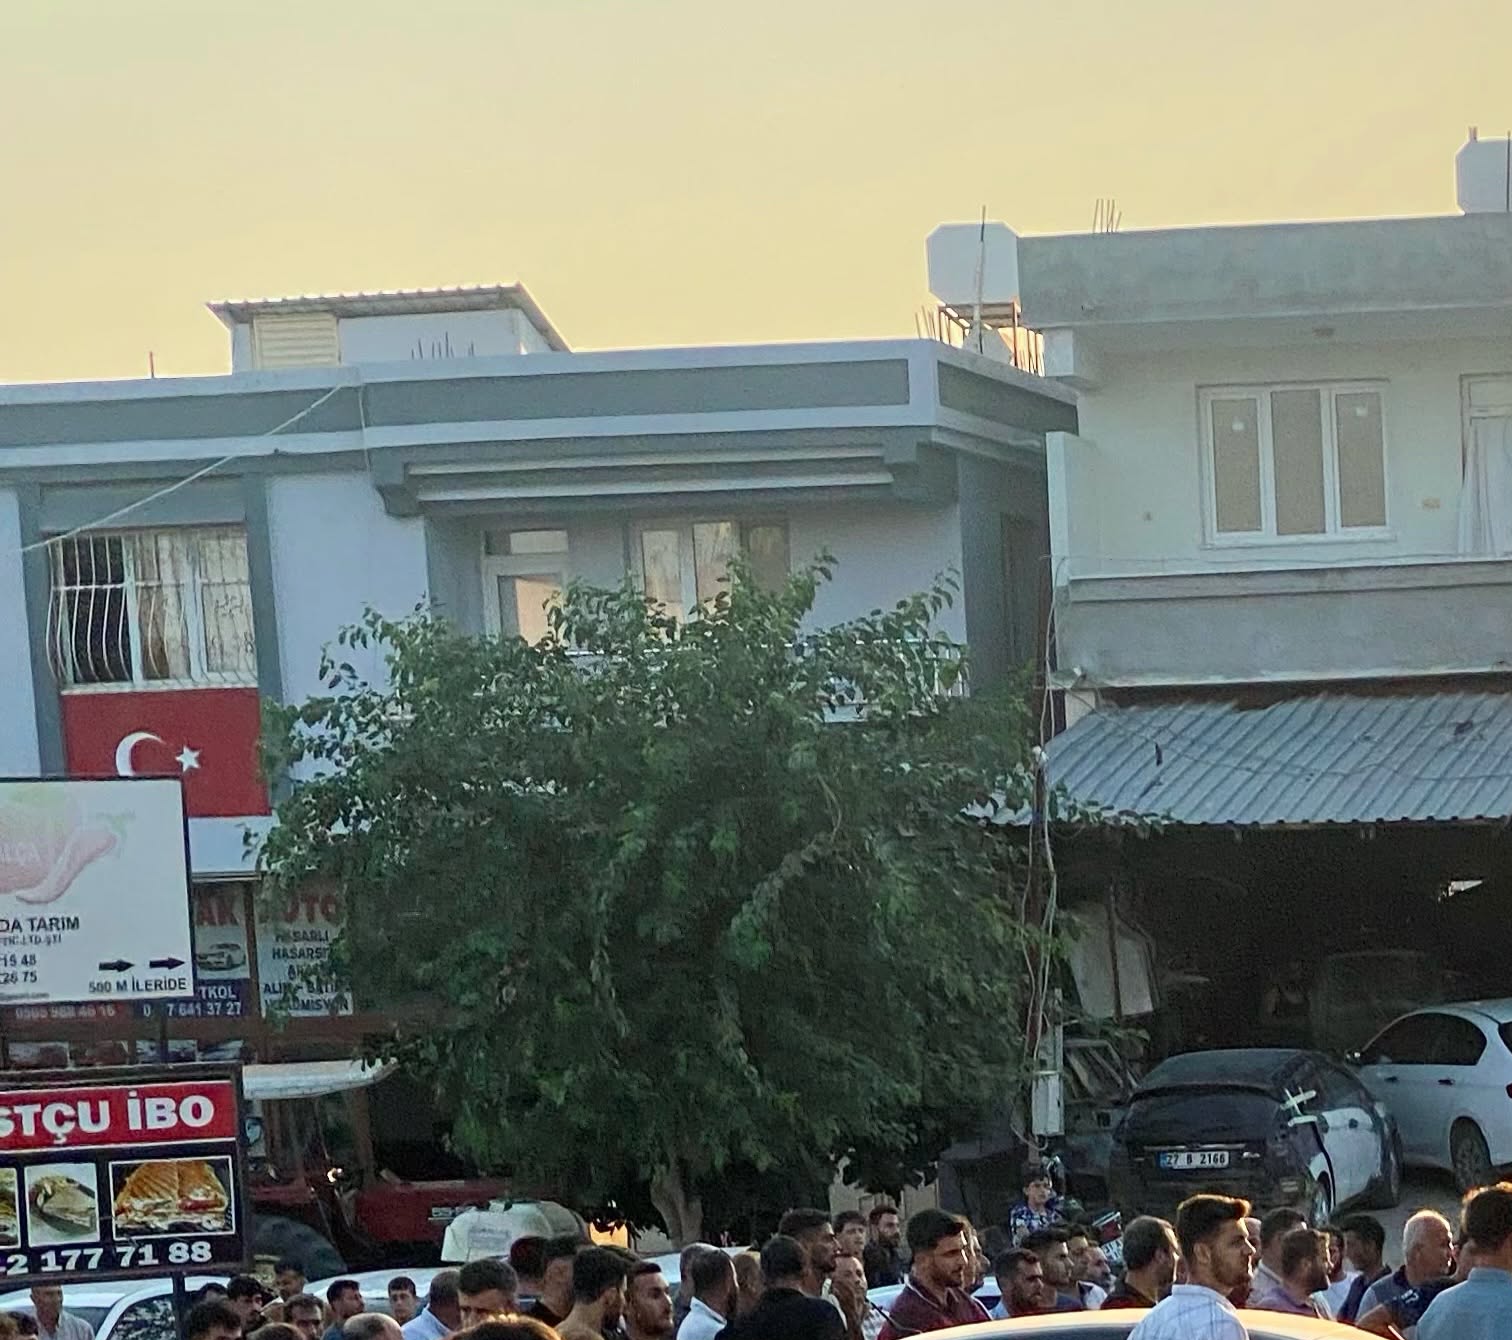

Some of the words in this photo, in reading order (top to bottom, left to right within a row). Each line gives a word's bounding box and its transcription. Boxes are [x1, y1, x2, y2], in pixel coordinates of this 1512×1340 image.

[23, 970, 38, 984] 75
[89, 981, 112, 993] 500
[116, 980, 128, 991] M
[132, 976, 187, 992] İLERİDE
[207, 1003, 221, 1015] 37
[226, 1002, 241, 1015] 27
[127, 1090, 215, 1131] İBO
[41, 1247, 103, 1272] 177
[116, 1243, 159, 1268] 71
[168, 1240, 213, 1264] 88
